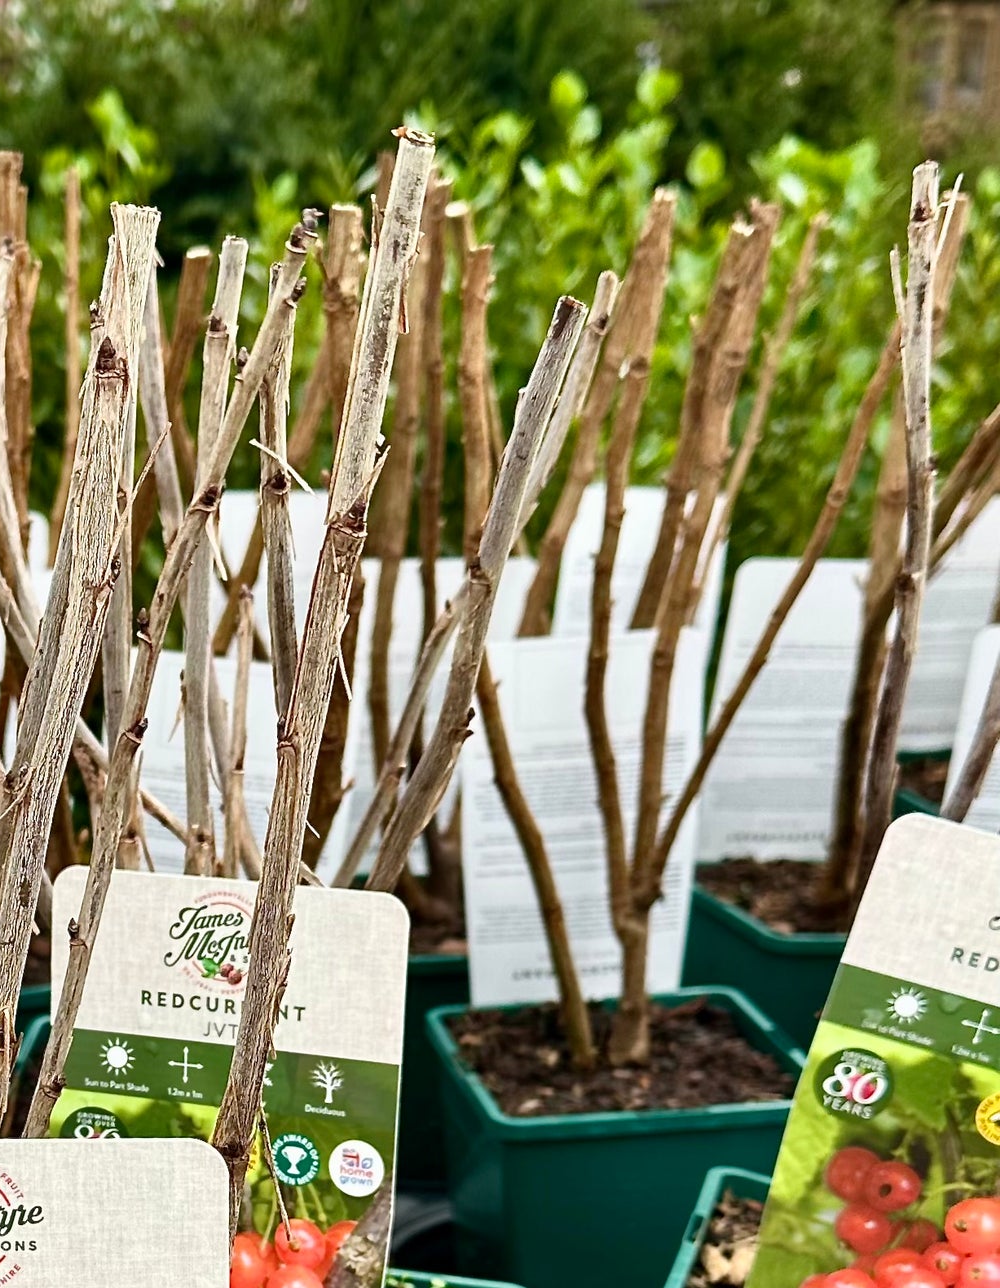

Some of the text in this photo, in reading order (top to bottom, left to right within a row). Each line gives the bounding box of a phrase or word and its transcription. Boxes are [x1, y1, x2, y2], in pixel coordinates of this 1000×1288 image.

[169, 905, 243, 940] James
[141, 990, 306, 1022] REDCURNT
[203, 1022, 239, 1039] JVT
[822, 1062, 888, 1104] 80
[304, 1104, 346, 1117] Deciduous
[823, 1094, 872, 1119] YEARS
[340, 1165, 373, 1178] home
[340, 1176, 373, 1186] grown
[0, 1172, 24, 1199] FRUIT
